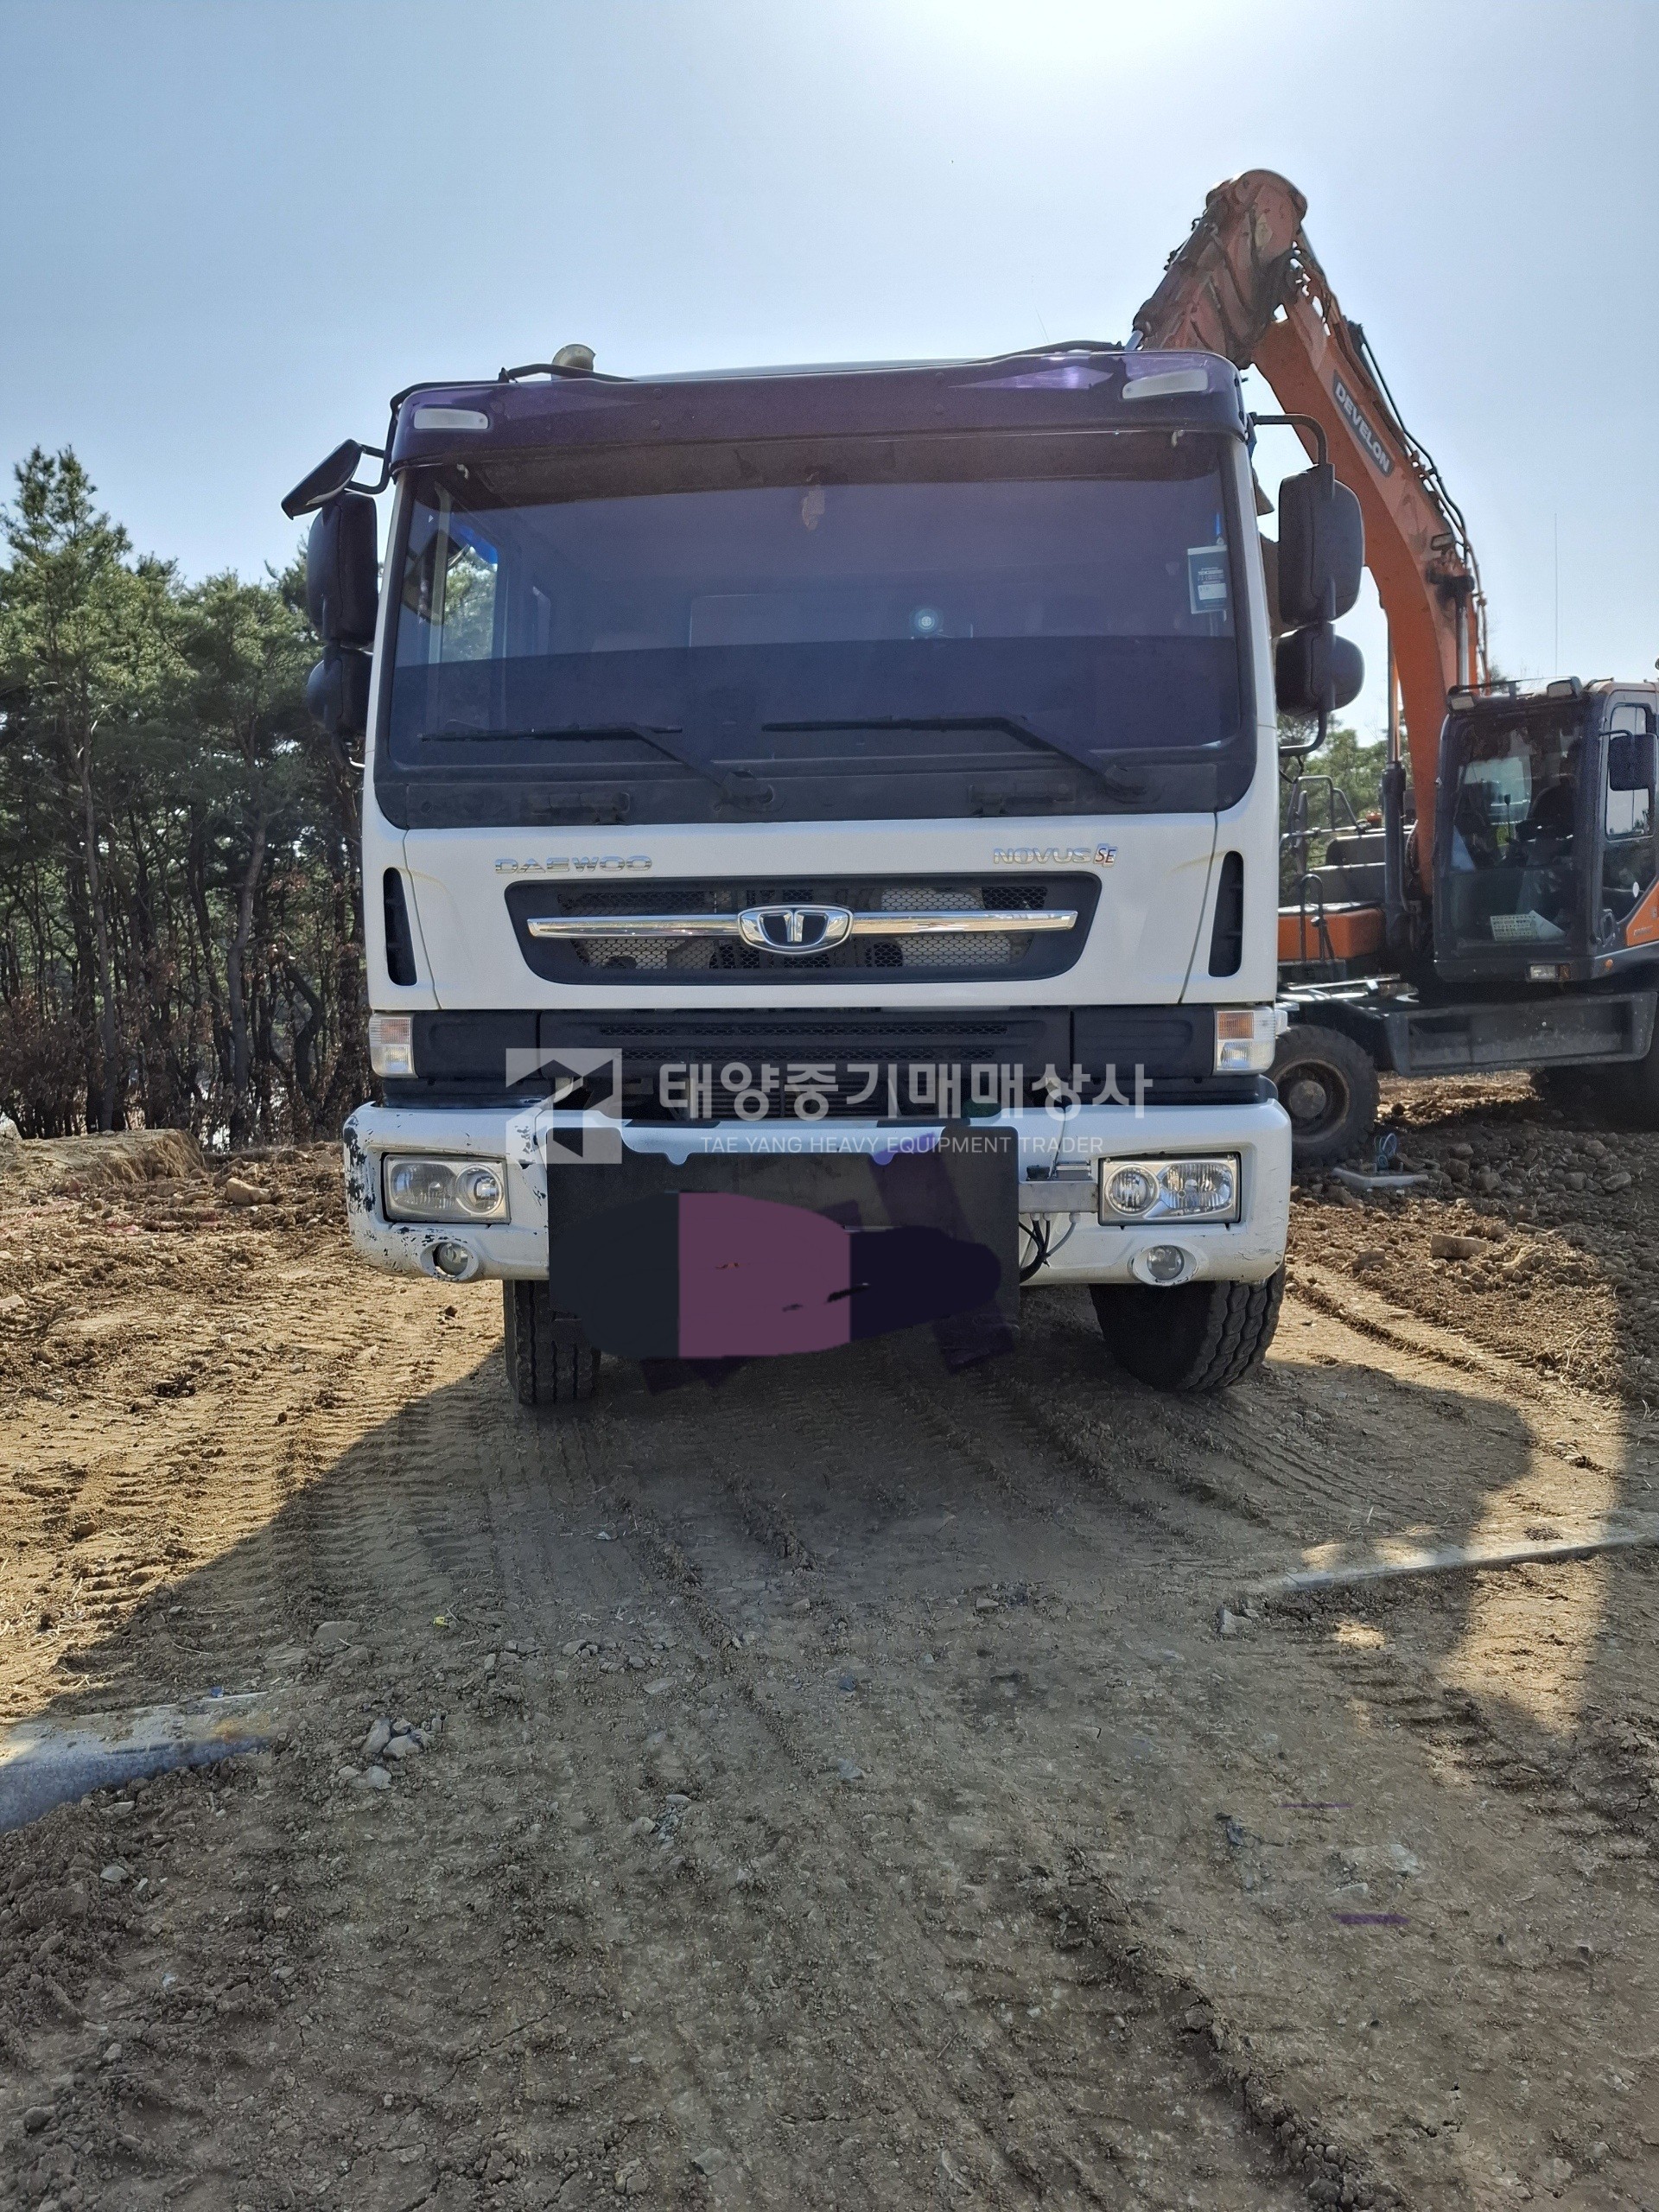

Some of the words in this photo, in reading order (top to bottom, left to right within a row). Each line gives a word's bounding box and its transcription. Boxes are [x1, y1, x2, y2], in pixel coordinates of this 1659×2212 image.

[1335, 381, 1389, 474] DEVELON
[495, 855, 653, 874] DAEWOO
[994, 848, 1091, 864] NOVUS
[1095, 846, 1117, 864] SE
